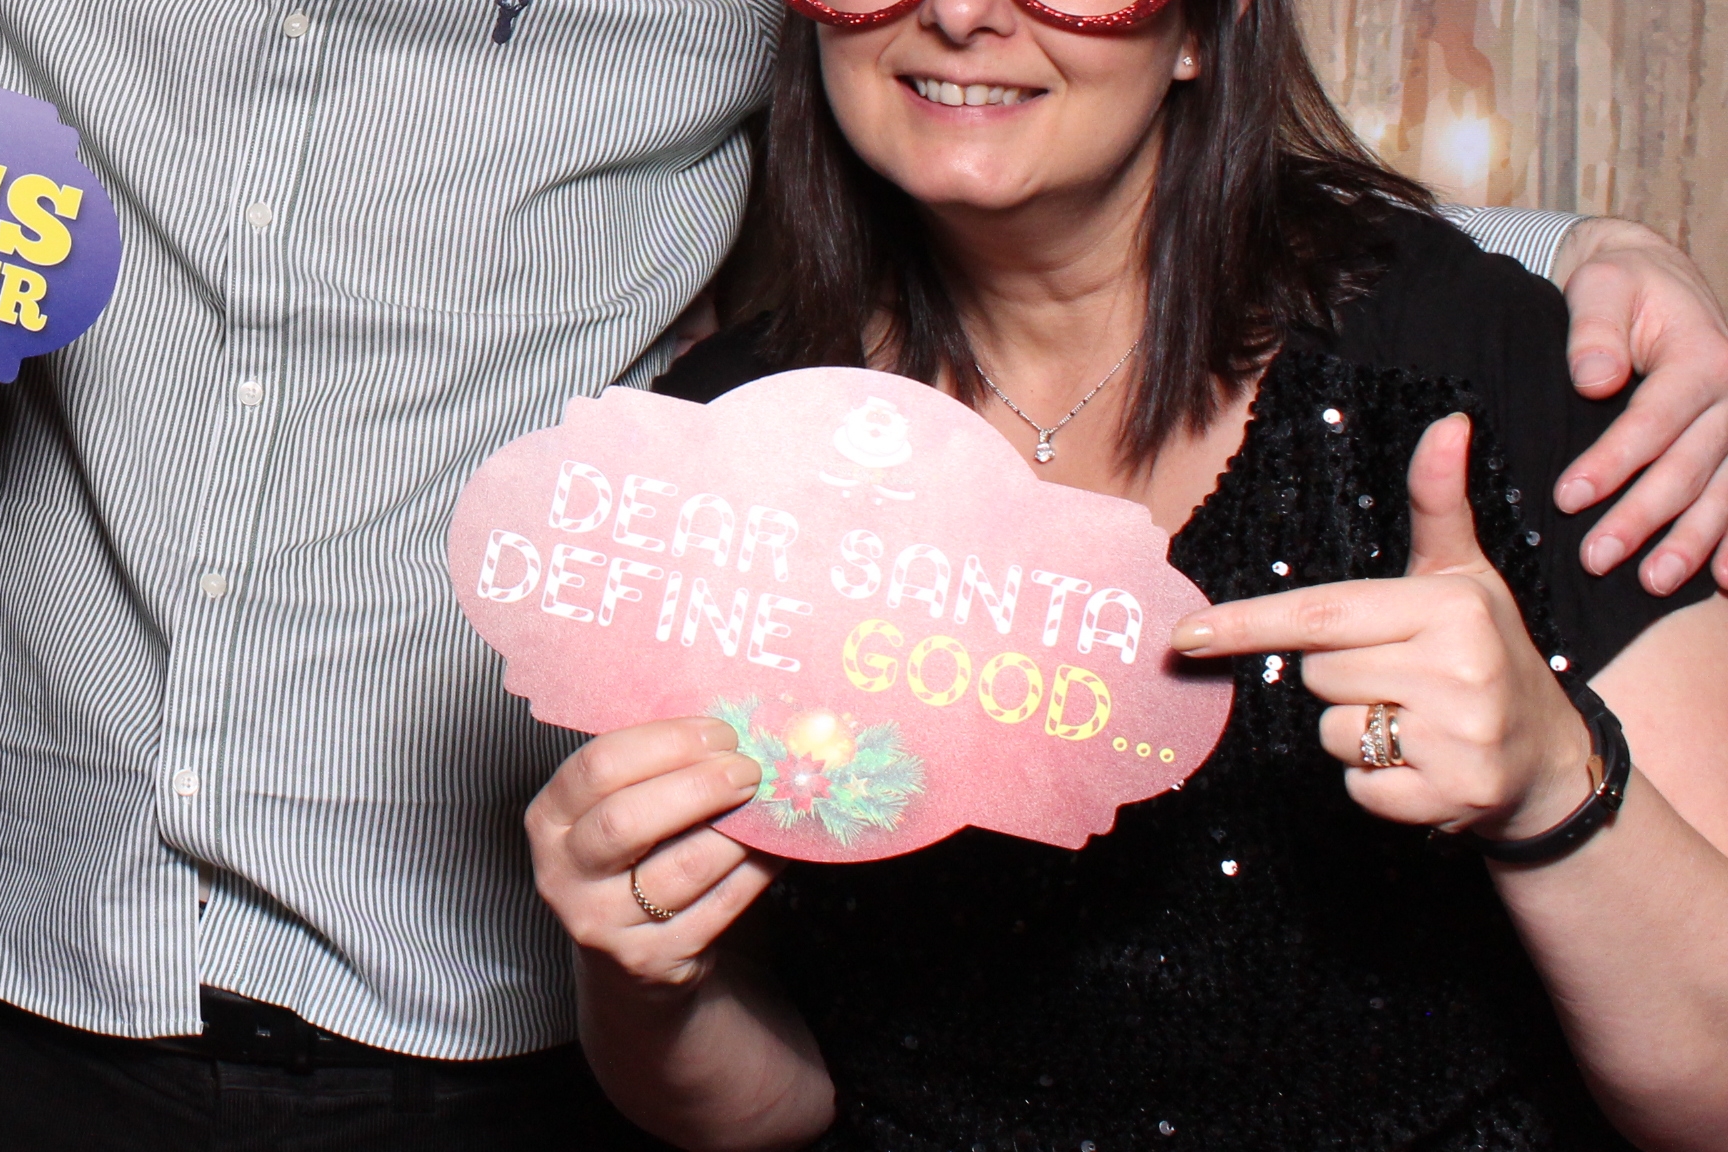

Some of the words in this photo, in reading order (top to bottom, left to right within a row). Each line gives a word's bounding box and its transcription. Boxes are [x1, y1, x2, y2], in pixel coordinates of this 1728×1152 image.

[476, 528, 813, 673] DEFINE
[548, 459, 800, 582] DEAR
[829, 529, 1144, 663] SANTA
